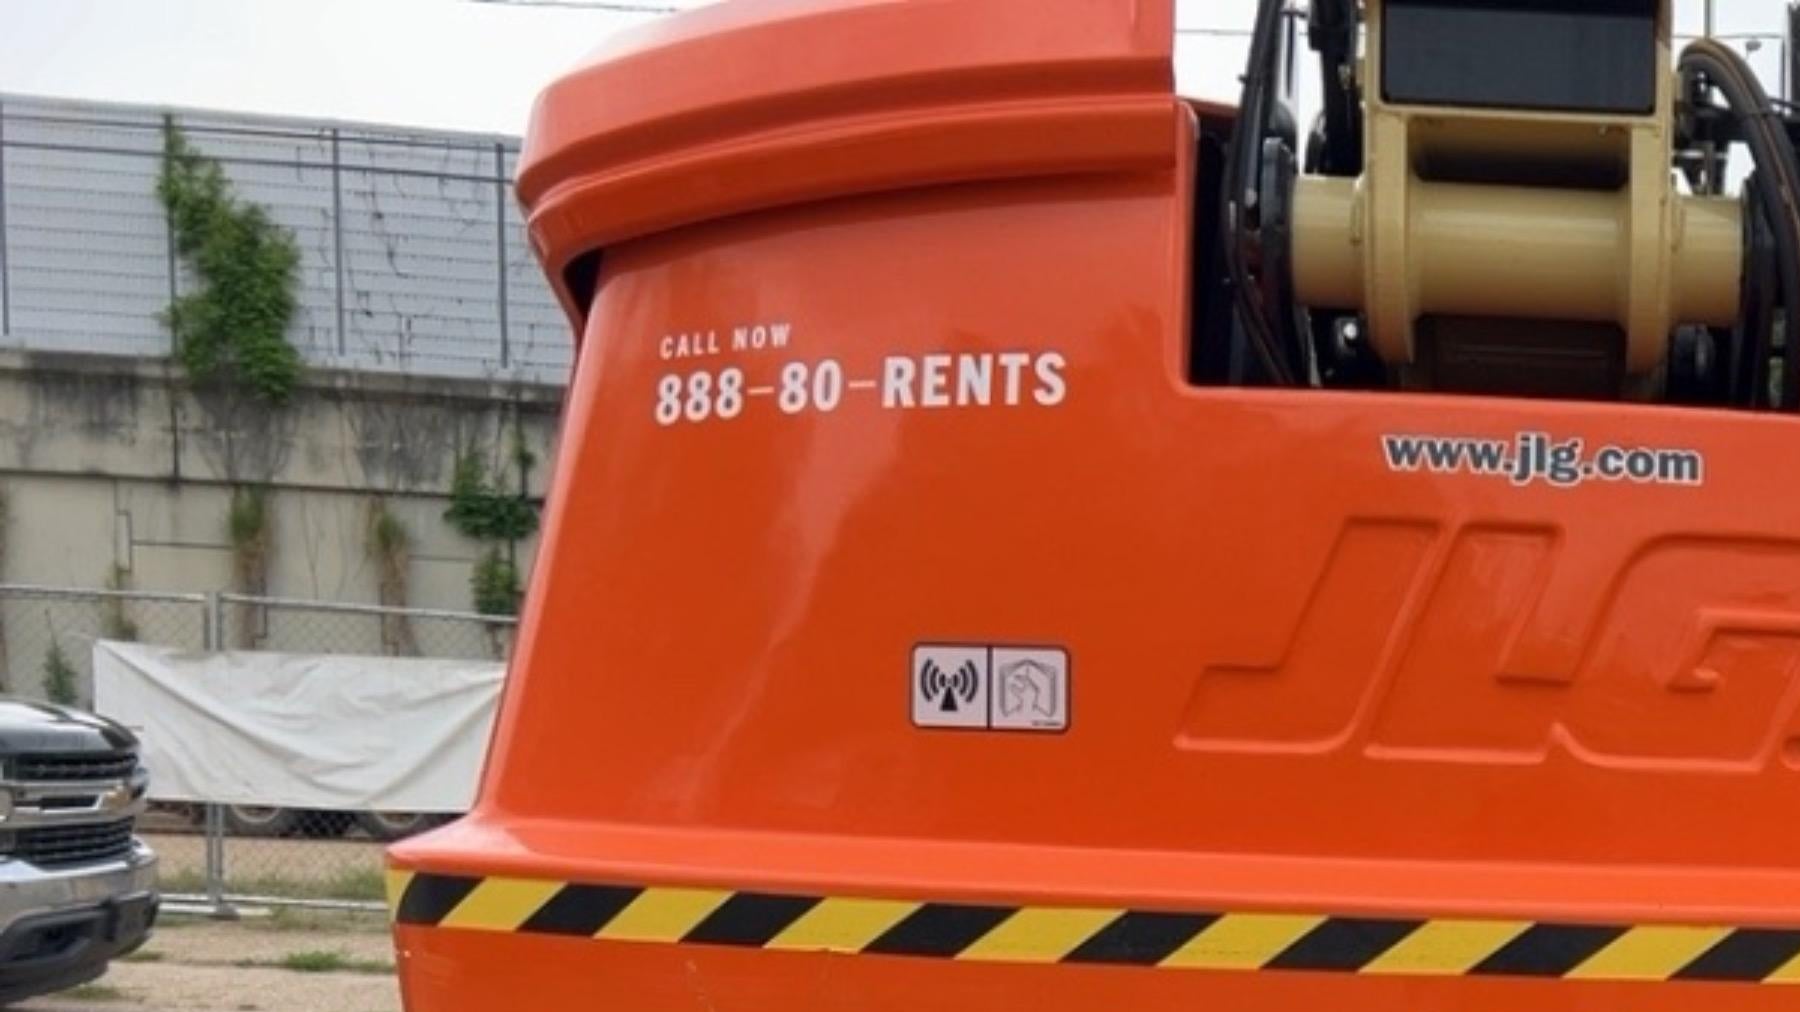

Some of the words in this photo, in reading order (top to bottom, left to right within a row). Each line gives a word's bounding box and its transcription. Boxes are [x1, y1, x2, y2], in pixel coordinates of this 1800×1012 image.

[660, 331, 718, 360] CALL
[733, 324, 792, 352] NOW
[654, 352, 1068, 426] 888-80-RENTS
[1383, 434, 1703, 484] www.jlg.com
